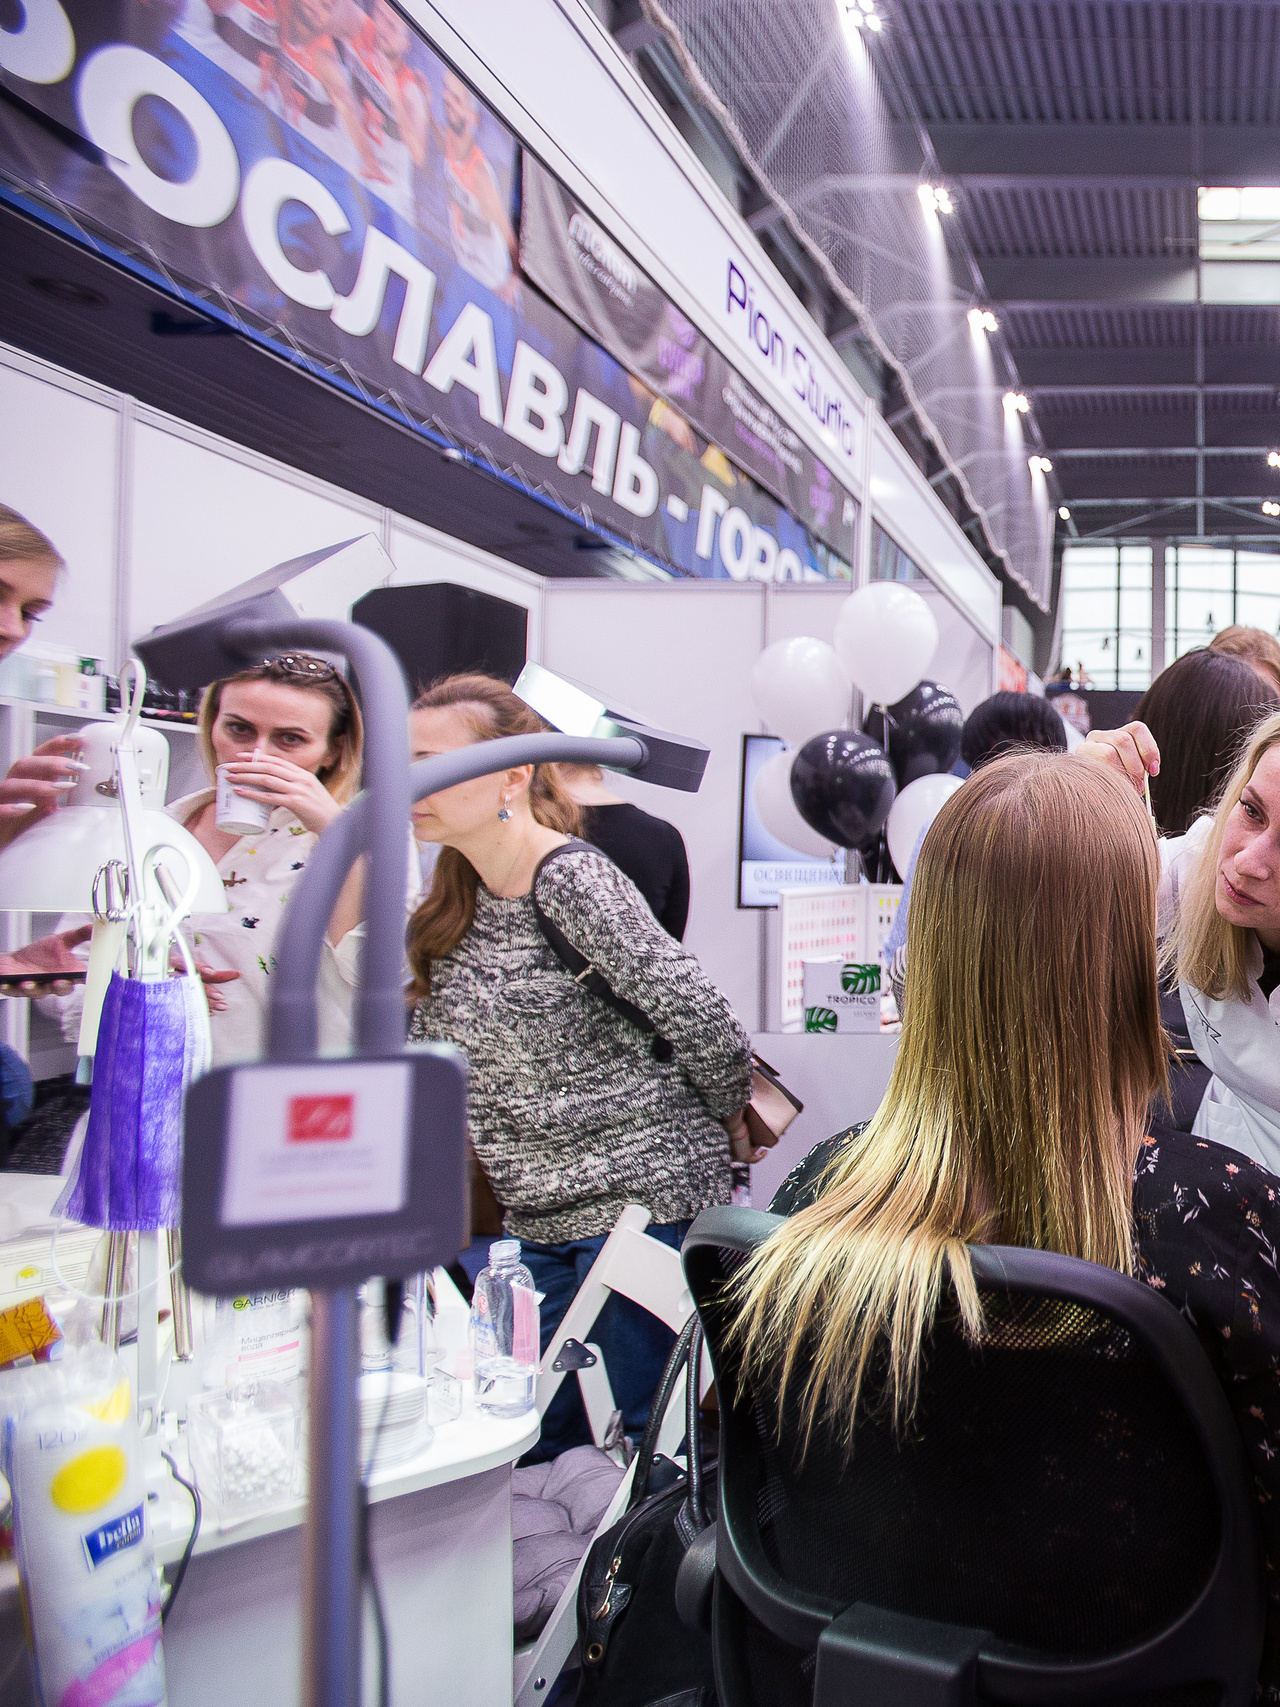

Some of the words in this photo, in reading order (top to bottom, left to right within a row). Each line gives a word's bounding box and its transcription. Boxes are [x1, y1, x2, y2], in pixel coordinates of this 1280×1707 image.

[726, 258, 787, 377] Pion
[753, 866, 846, 885] ОСВЕЩЕНИ
[826, 994, 877, 1006] TROPICO
[232, 1288, 296, 1310] GARNIER
[241, 1343, 263, 1353] вода
[98, 1513, 141, 1551] bella
